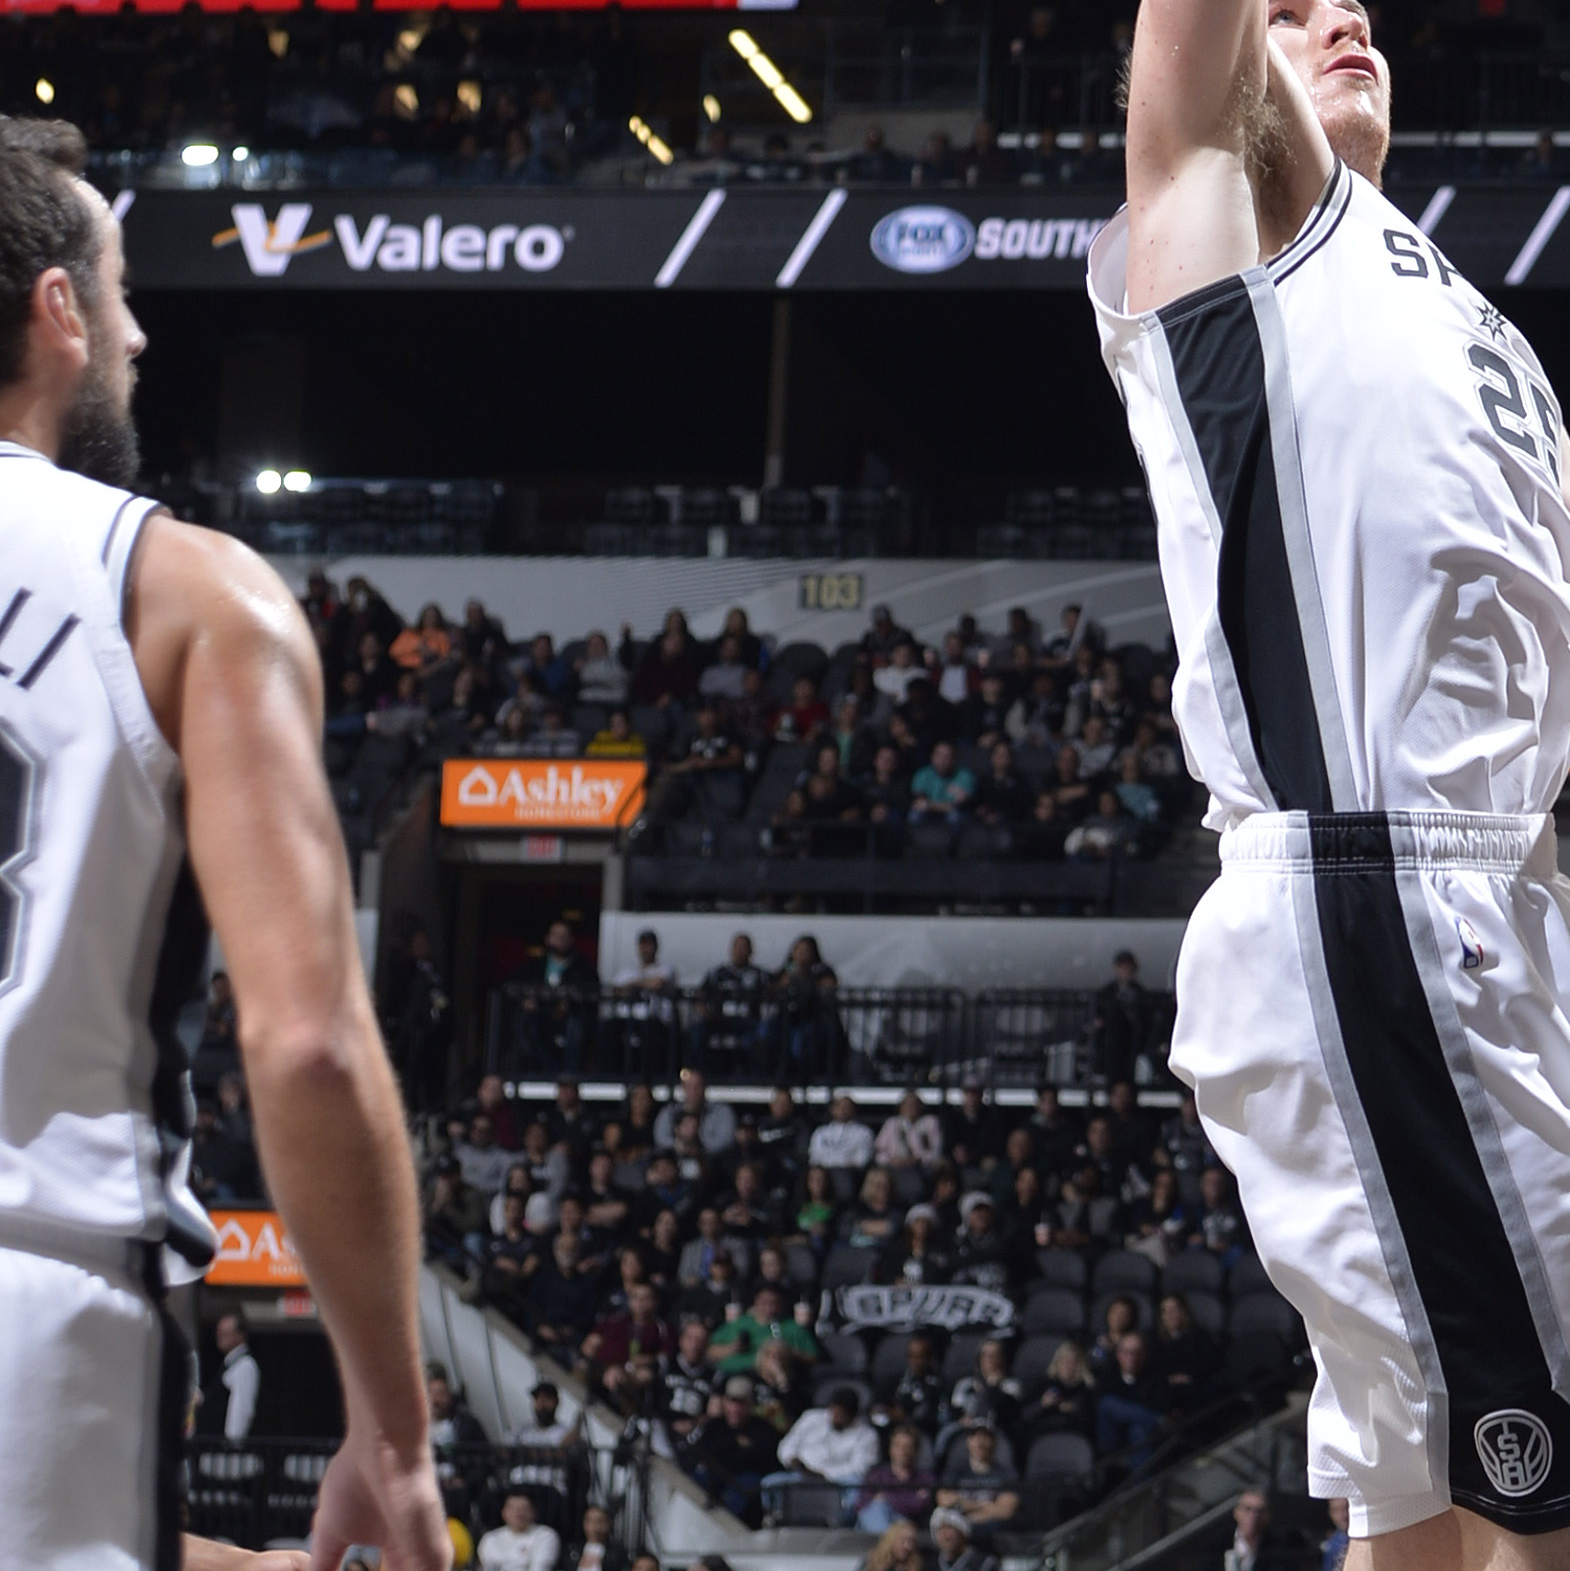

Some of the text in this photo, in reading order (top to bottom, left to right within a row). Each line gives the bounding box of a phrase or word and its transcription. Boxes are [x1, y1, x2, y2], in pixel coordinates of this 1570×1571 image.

[334, 213, 565, 272] Valero
[803, 575, 858, 607] 103
[499, 764, 624, 816] Ashley
